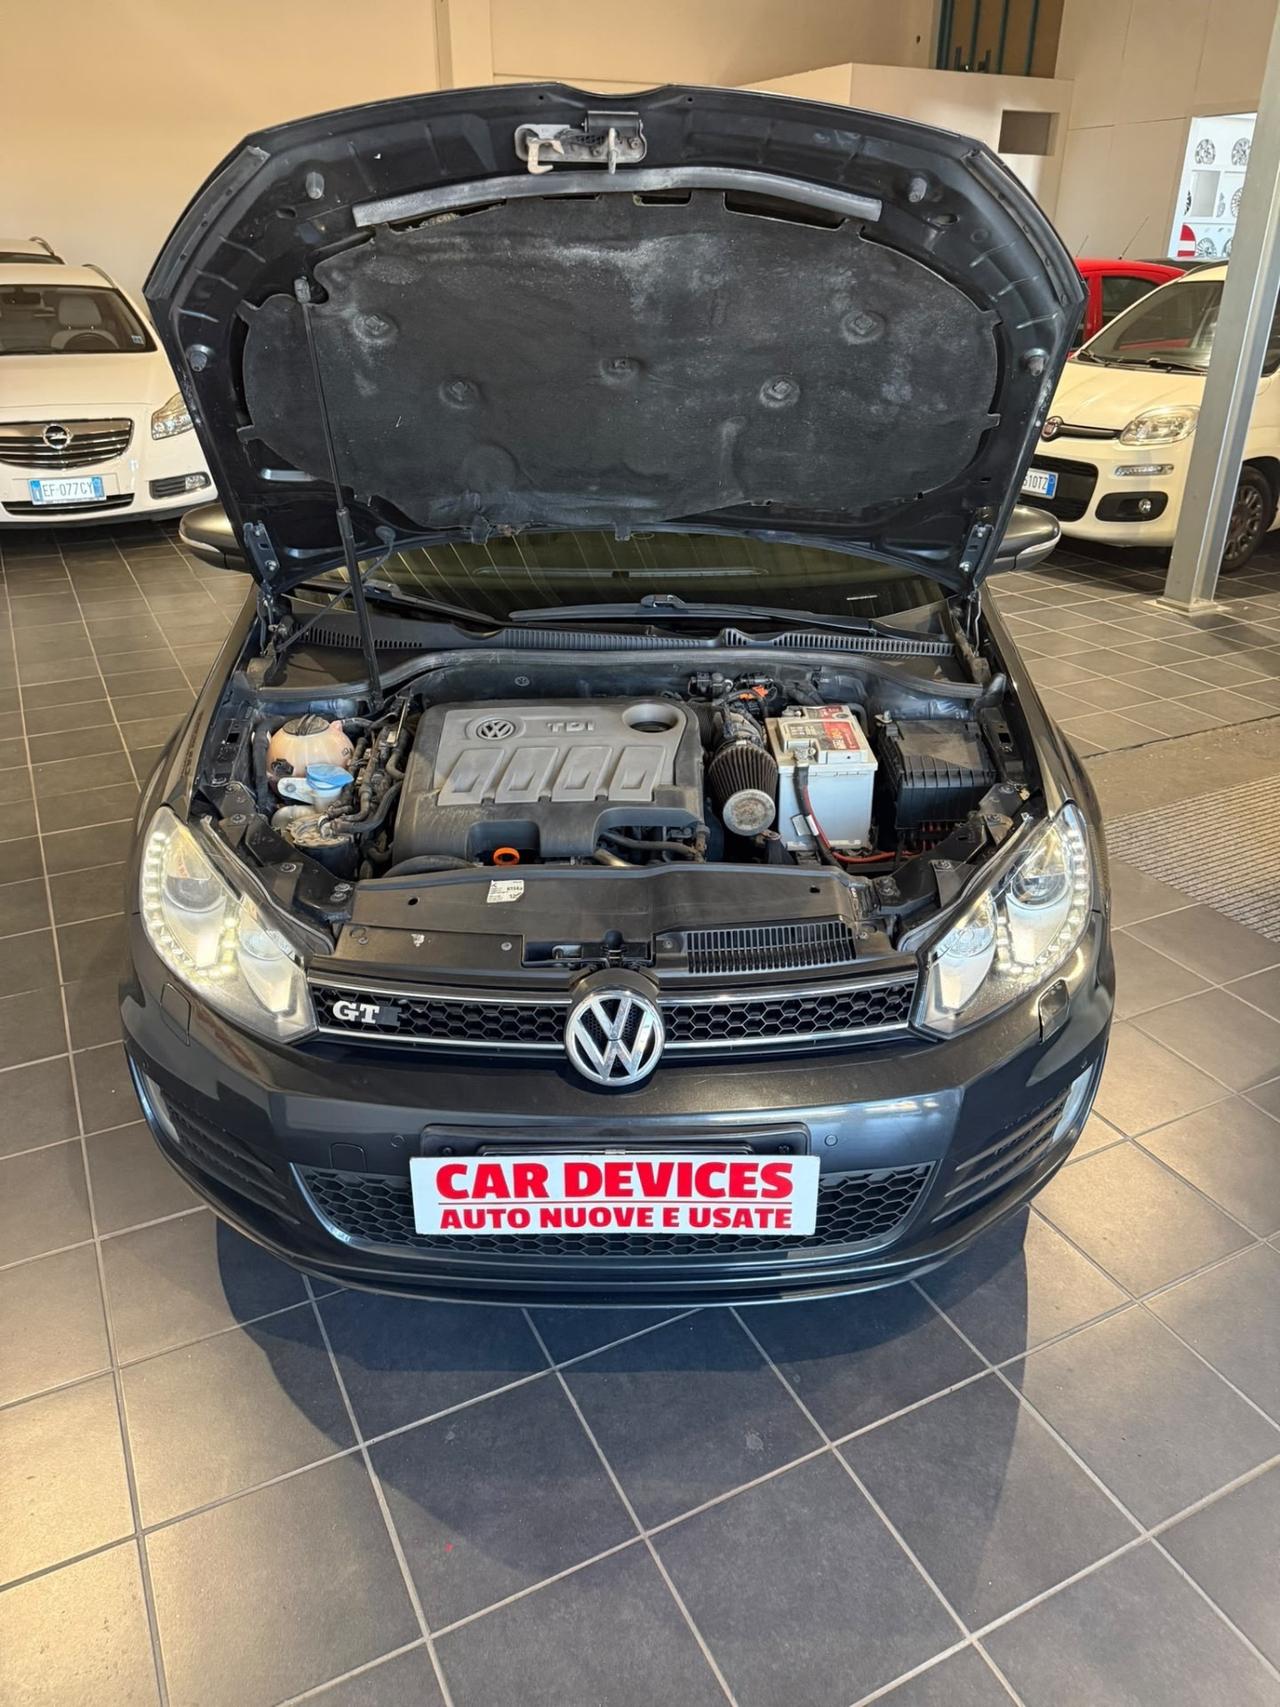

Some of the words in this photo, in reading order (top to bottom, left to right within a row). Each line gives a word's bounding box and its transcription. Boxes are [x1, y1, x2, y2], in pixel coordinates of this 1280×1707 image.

[546, 721, 594, 733] TDI
[332, 1000, 380, 1024] GT
[435, 1162, 550, 1200] CAR
[563, 1161, 794, 1199] DEVICES
[440, 1207, 532, 1229] AUTO
[539, 1207, 654, 1228] NUOVE
[662, 1207, 680, 1228] E
[688, 1207, 793, 1229] USATE
